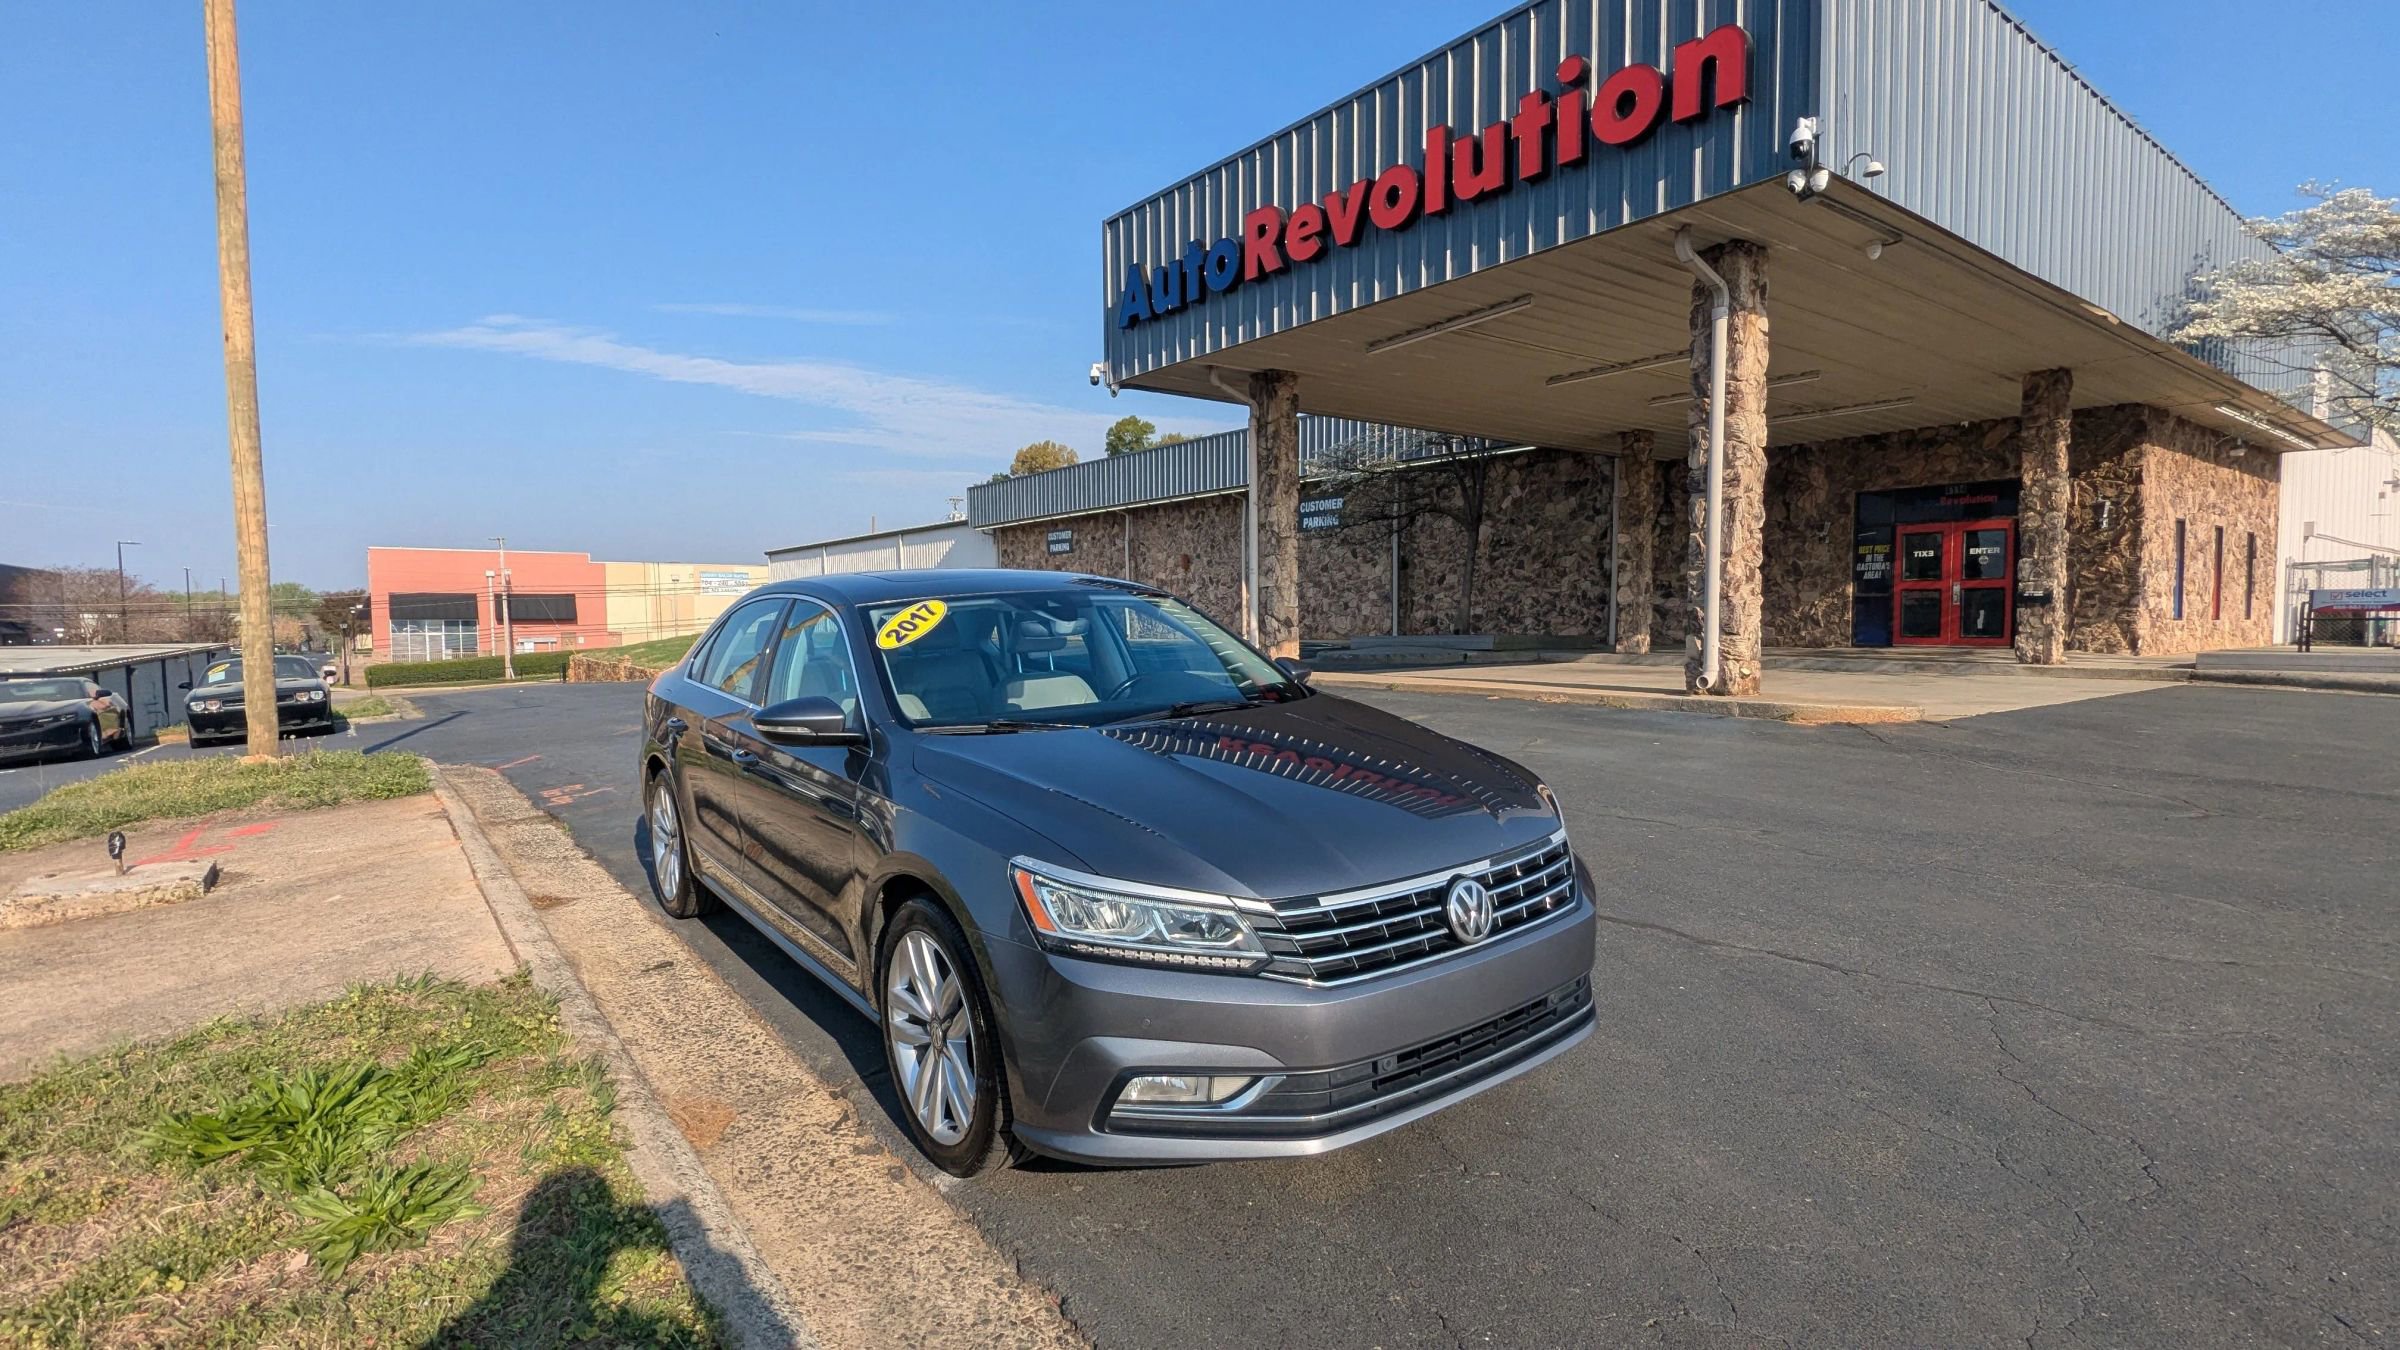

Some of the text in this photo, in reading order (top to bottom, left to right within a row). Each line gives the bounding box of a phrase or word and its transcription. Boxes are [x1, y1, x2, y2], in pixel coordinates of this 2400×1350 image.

[1300, 498, 1344, 513] CUSTOMER
[1303, 515, 1339, 528] PARKING
[1048, 530, 1072, 540] CUSTOMER
[1049, 543, 1070, 552] PARKING
[1969, 546, 2000, 555] ENTER
[2345, 589, 2388, 598] select
[885, 603, 937, 643] 2017
